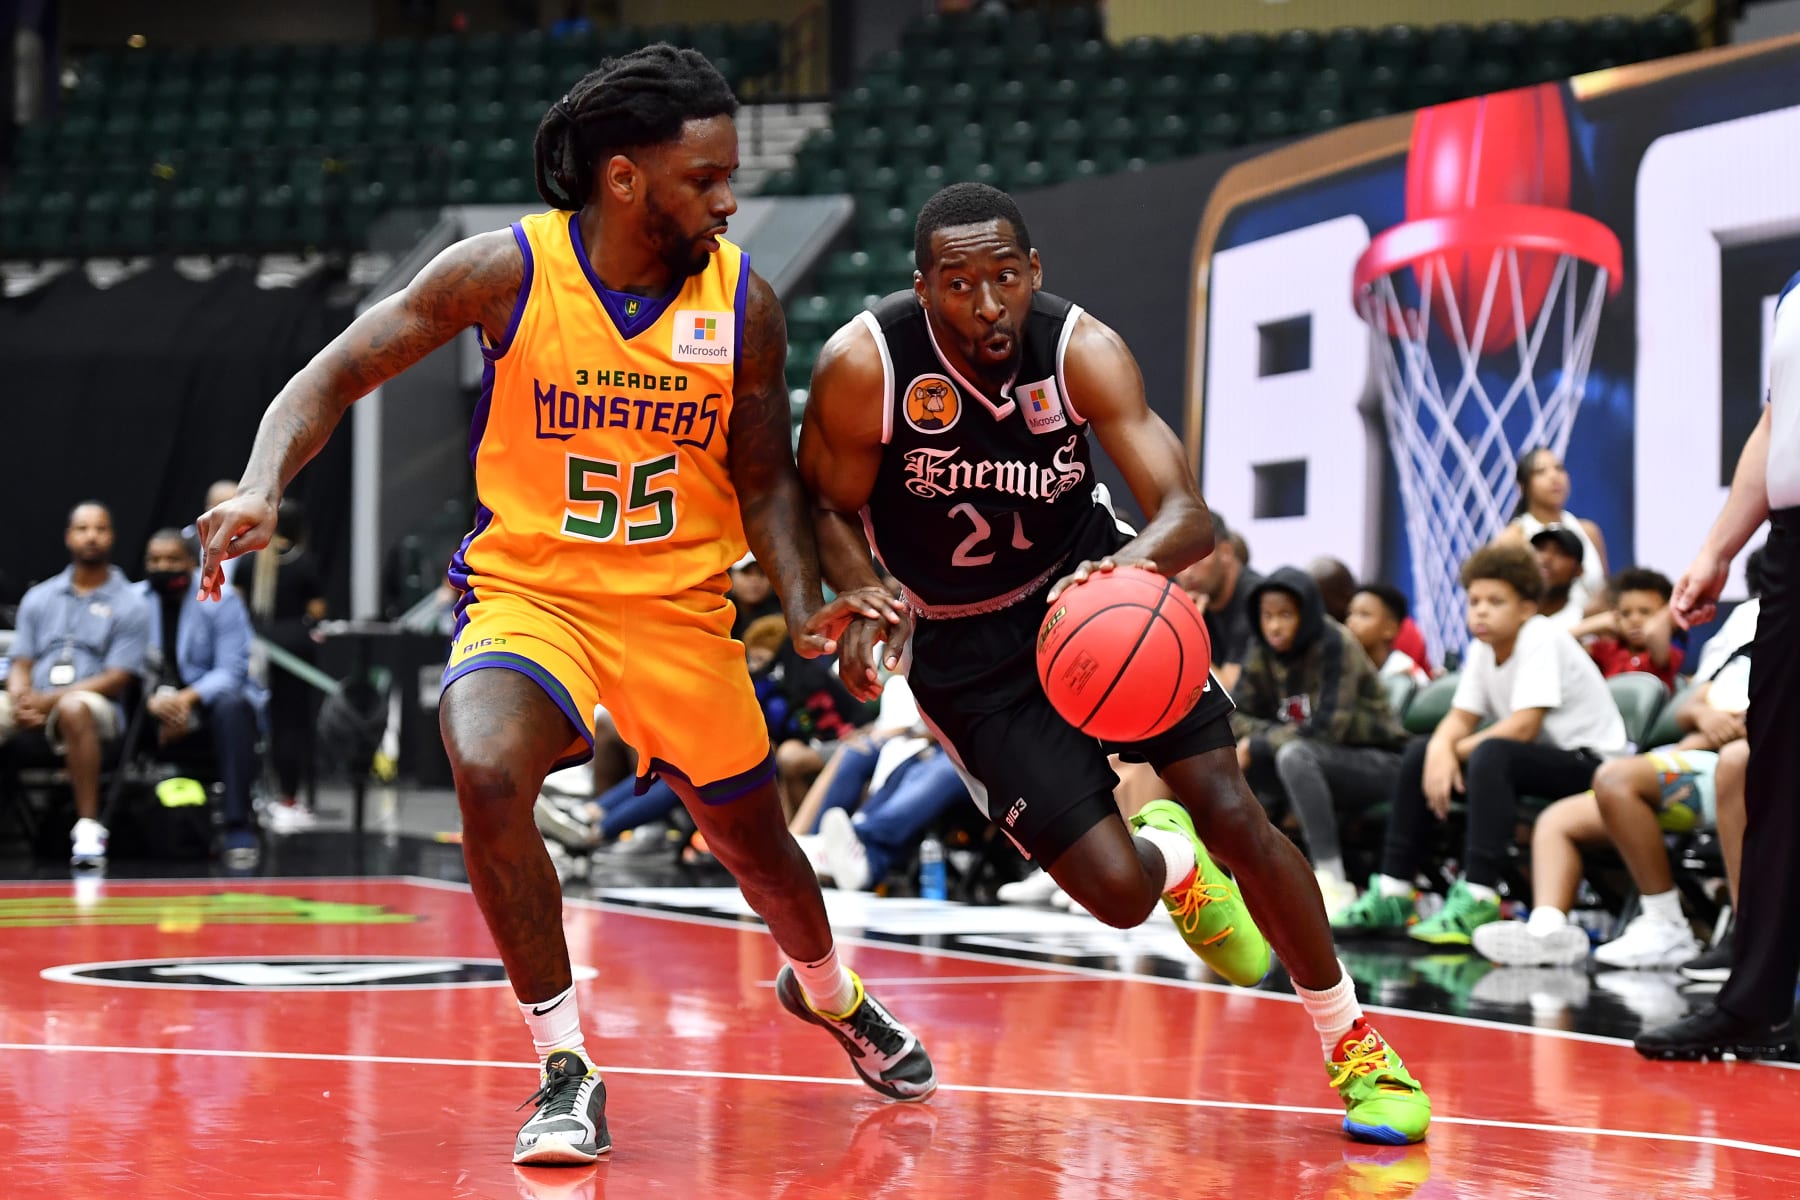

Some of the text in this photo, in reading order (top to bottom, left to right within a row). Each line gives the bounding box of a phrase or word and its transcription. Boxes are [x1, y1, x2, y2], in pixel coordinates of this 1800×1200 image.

[677, 343, 728, 357] Microsoft
[575, 369, 688, 391] 3 HEADED
[533, 378, 723, 451] MONSTERS
[560, 451, 680, 545] 55
[947, 502, 1035, 567] 21
[1005, 796, 1028, 828] BIG3
